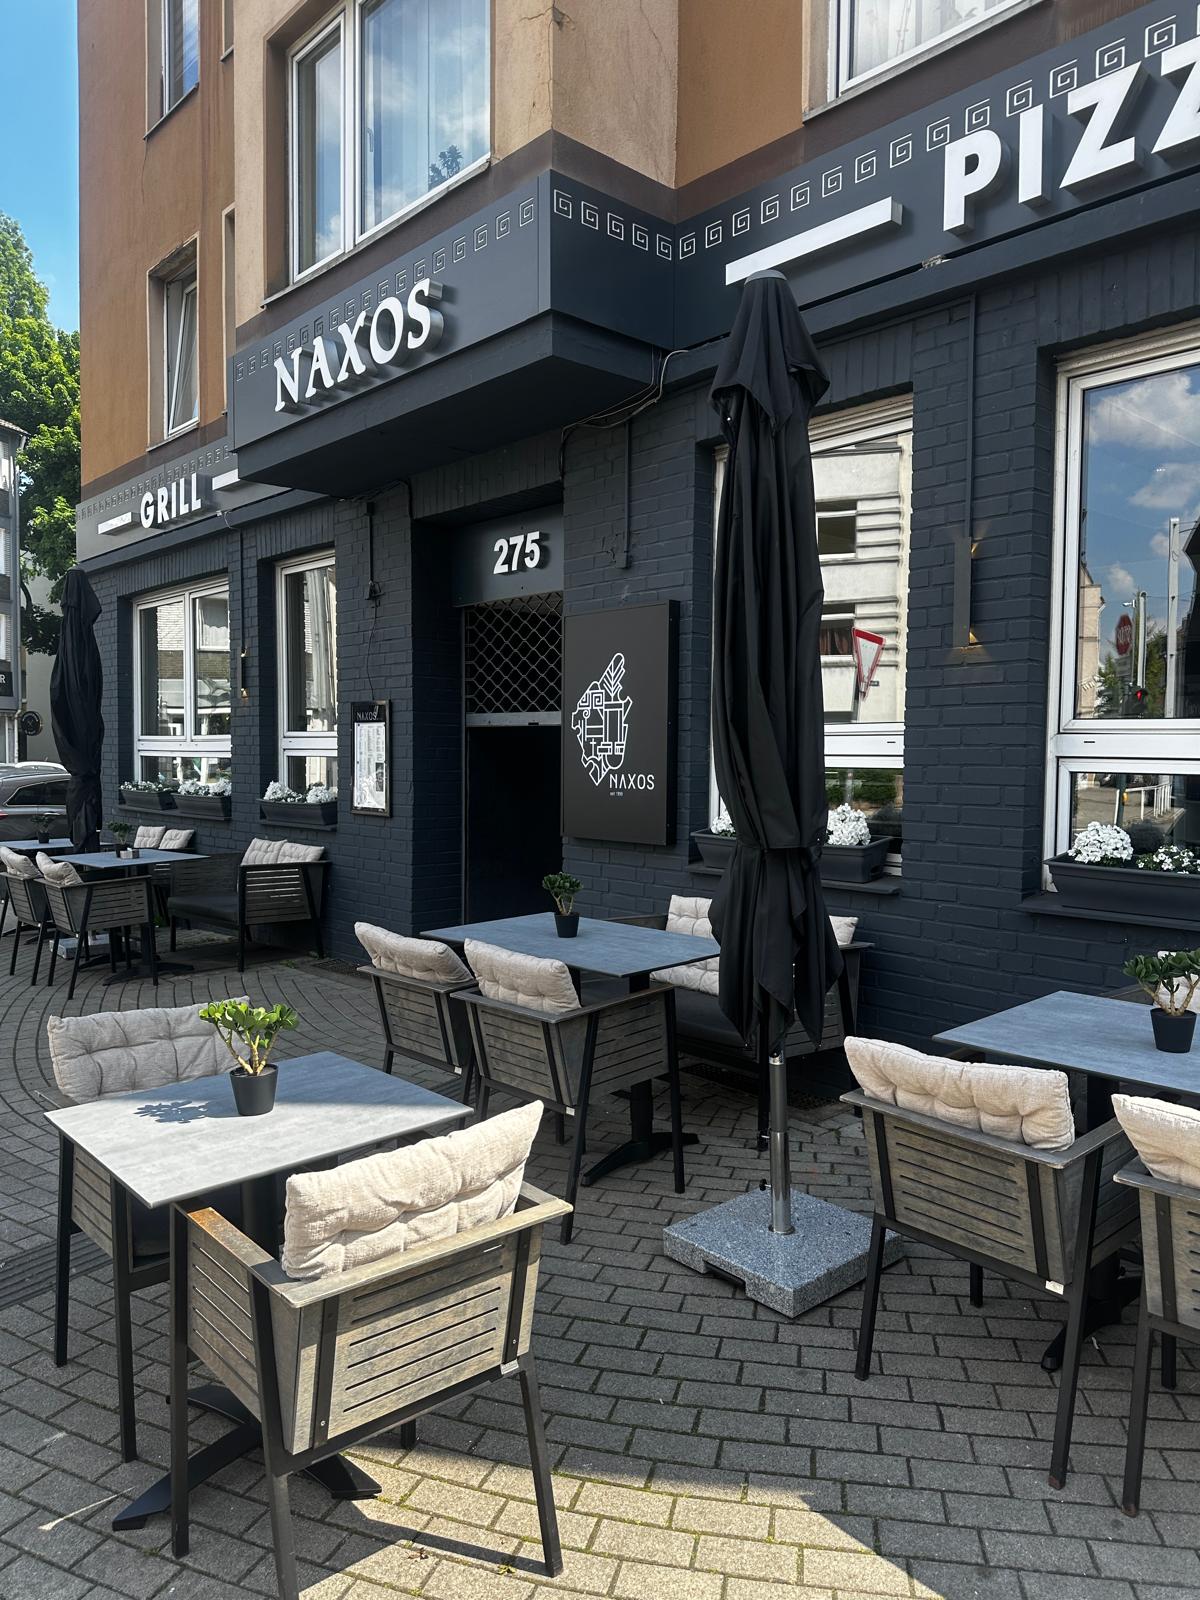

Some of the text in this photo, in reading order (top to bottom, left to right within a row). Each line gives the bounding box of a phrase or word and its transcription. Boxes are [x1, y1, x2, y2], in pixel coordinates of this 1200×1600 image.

[274, 278, 432, 412] NAXOS
[140, 472, 202, 529] GRILL
[493, 531, 540, 574] 275
[609, 773, 655, 790] NAXOS
